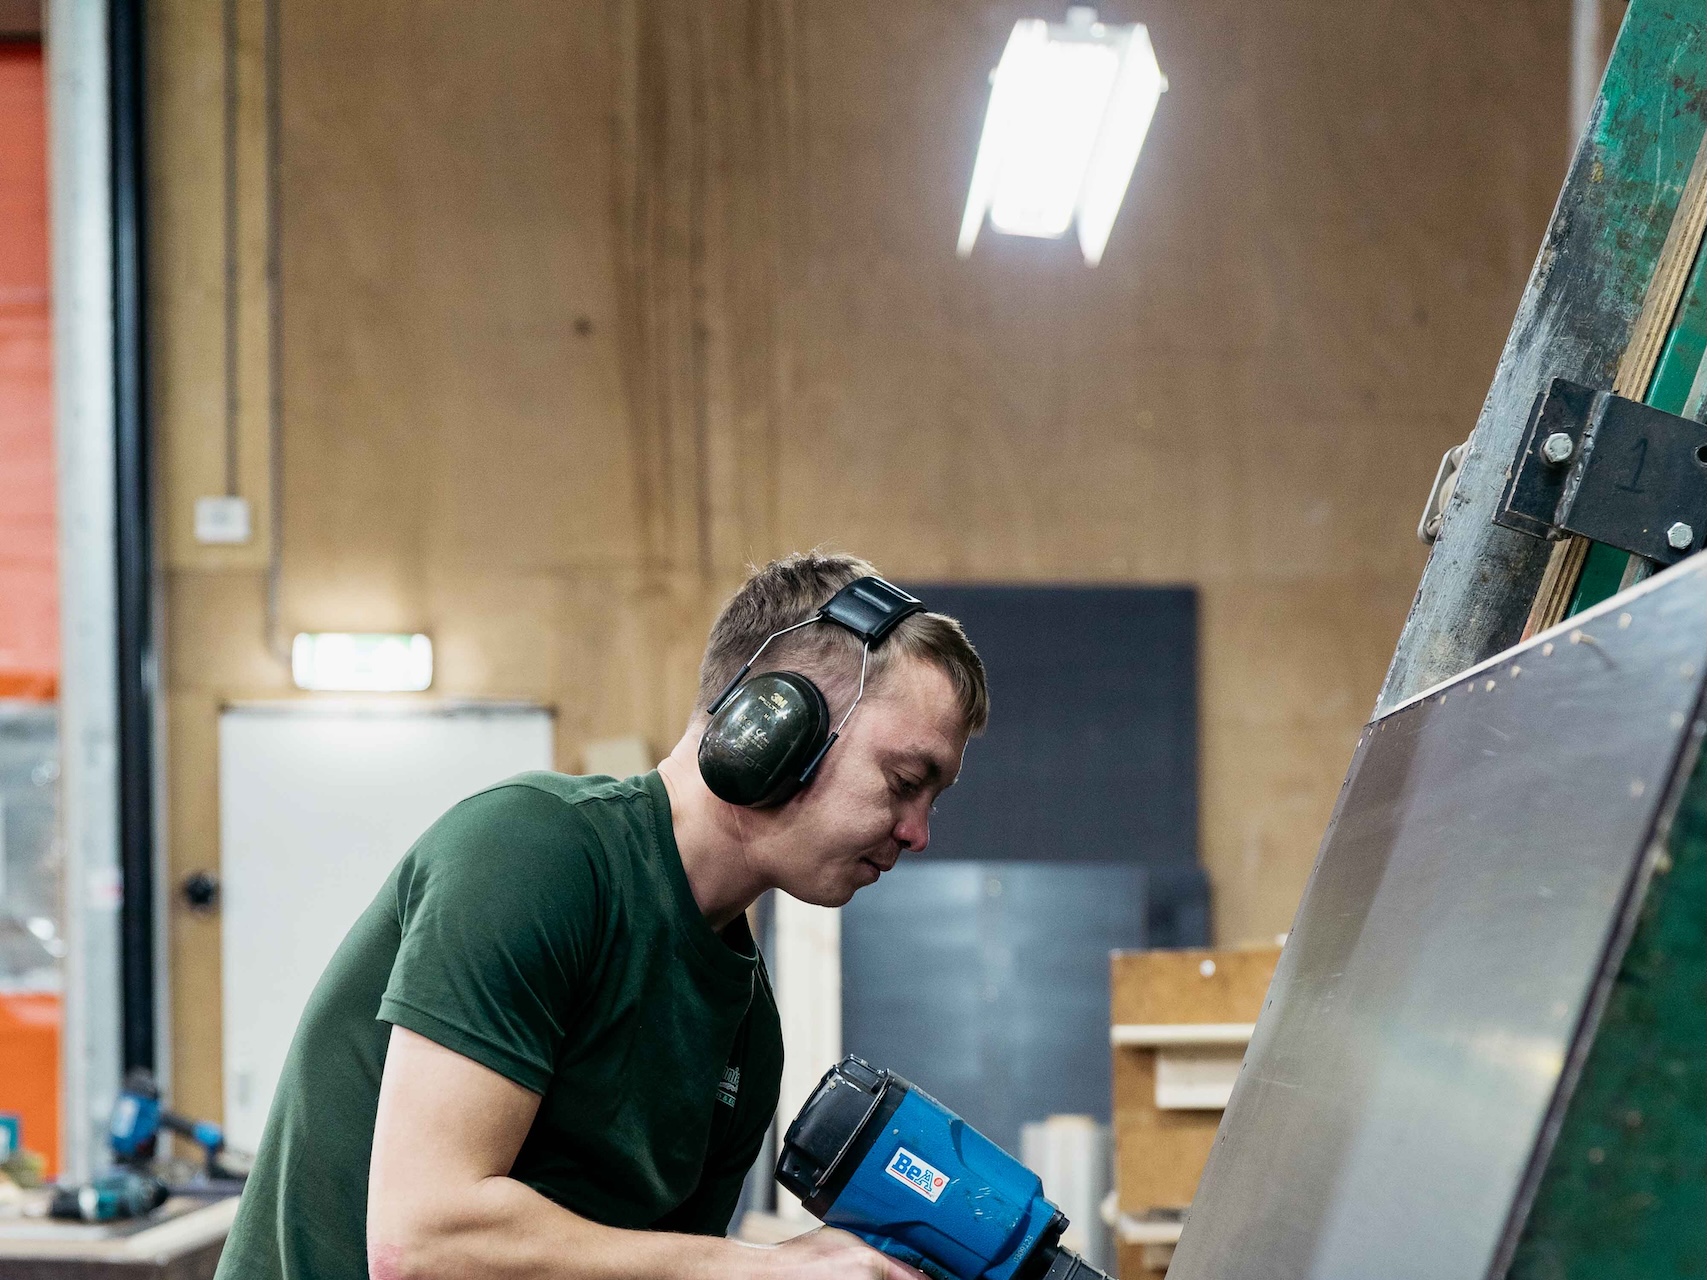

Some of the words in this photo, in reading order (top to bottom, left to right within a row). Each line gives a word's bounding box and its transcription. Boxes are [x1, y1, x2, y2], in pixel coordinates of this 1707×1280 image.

[1615, 438, 1648, 493] 1
[771, 692, 788, 709] 3M
[891, 1152, 934, 1192] BeA
